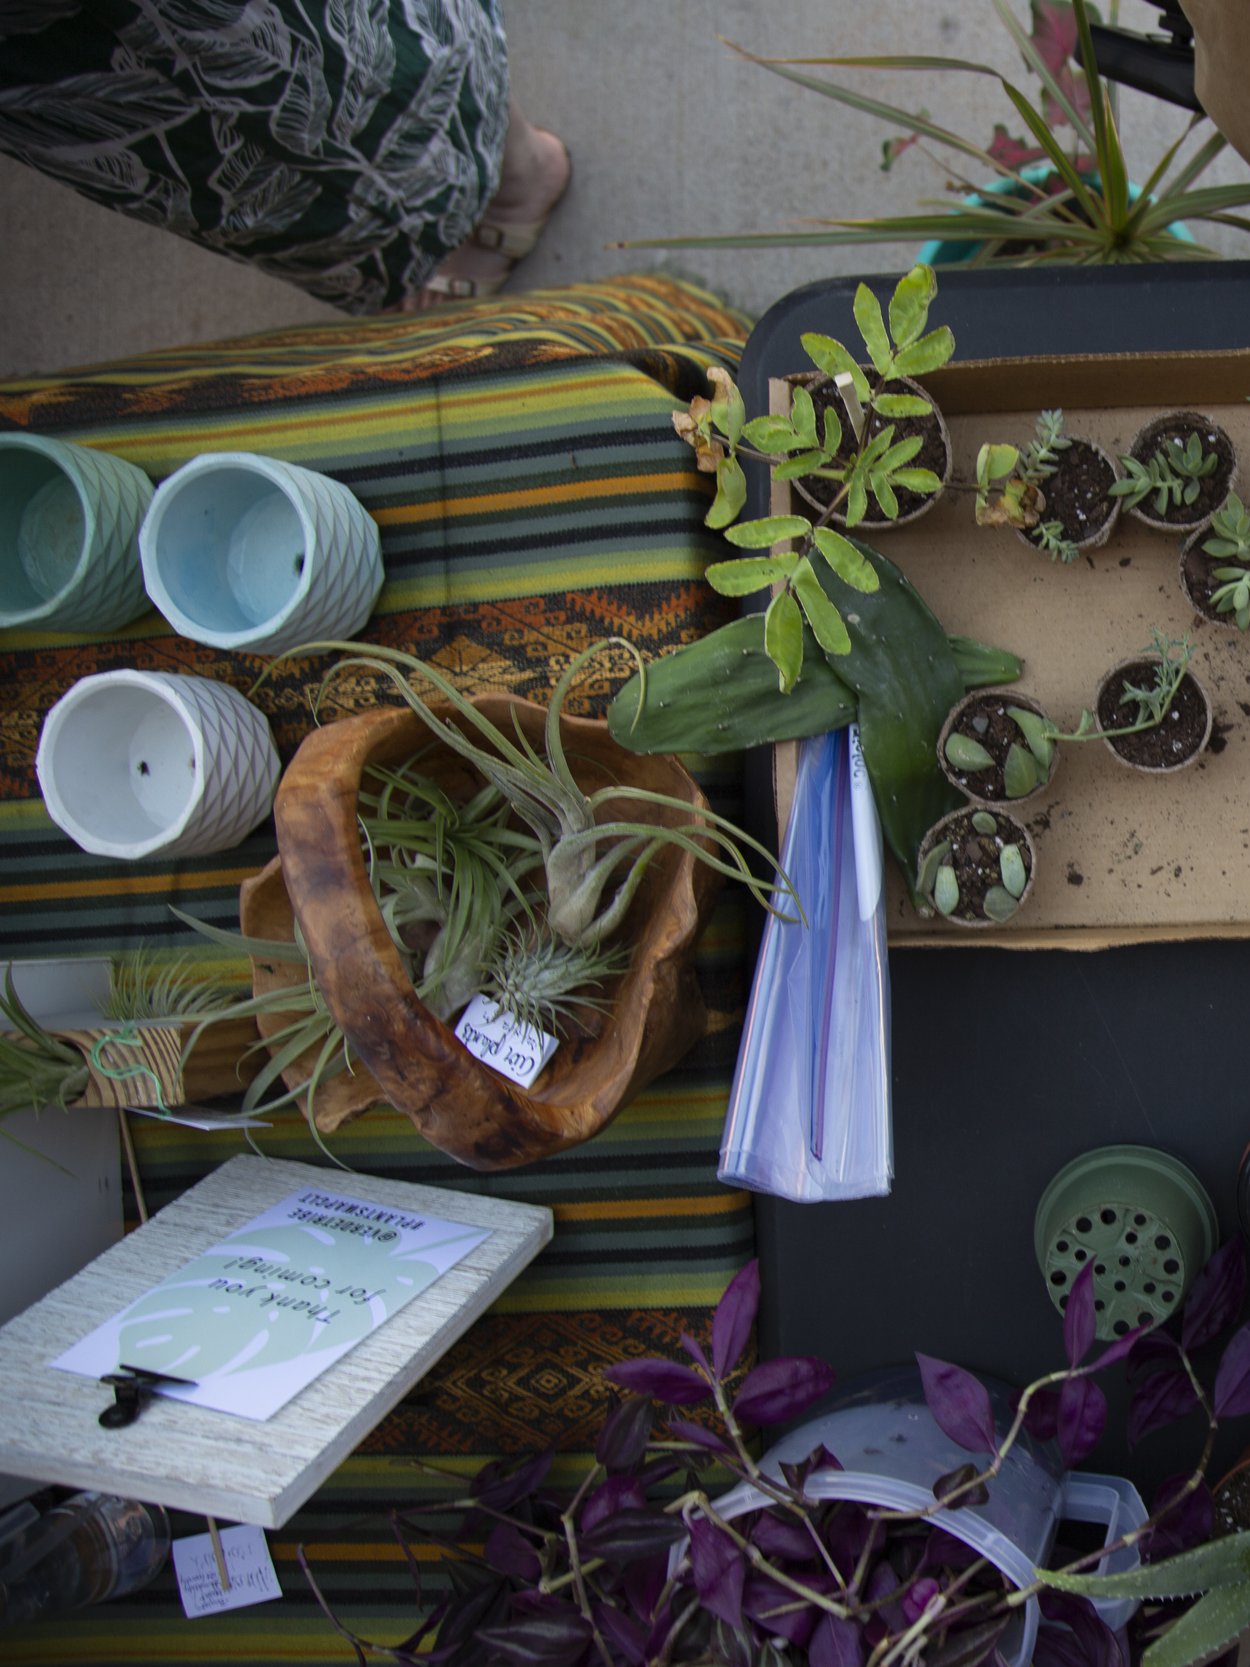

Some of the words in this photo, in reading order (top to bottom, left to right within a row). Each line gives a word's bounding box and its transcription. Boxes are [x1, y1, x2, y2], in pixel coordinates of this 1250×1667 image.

[288, 1207, 398, 1243] @VERDETRIBE
[207, 1277, 268, 1298] you
[223, 1256, 331, 1290] coming!
[260, 1292, 342, 1325] Thank
[335, 1285, 387, 1306] for
